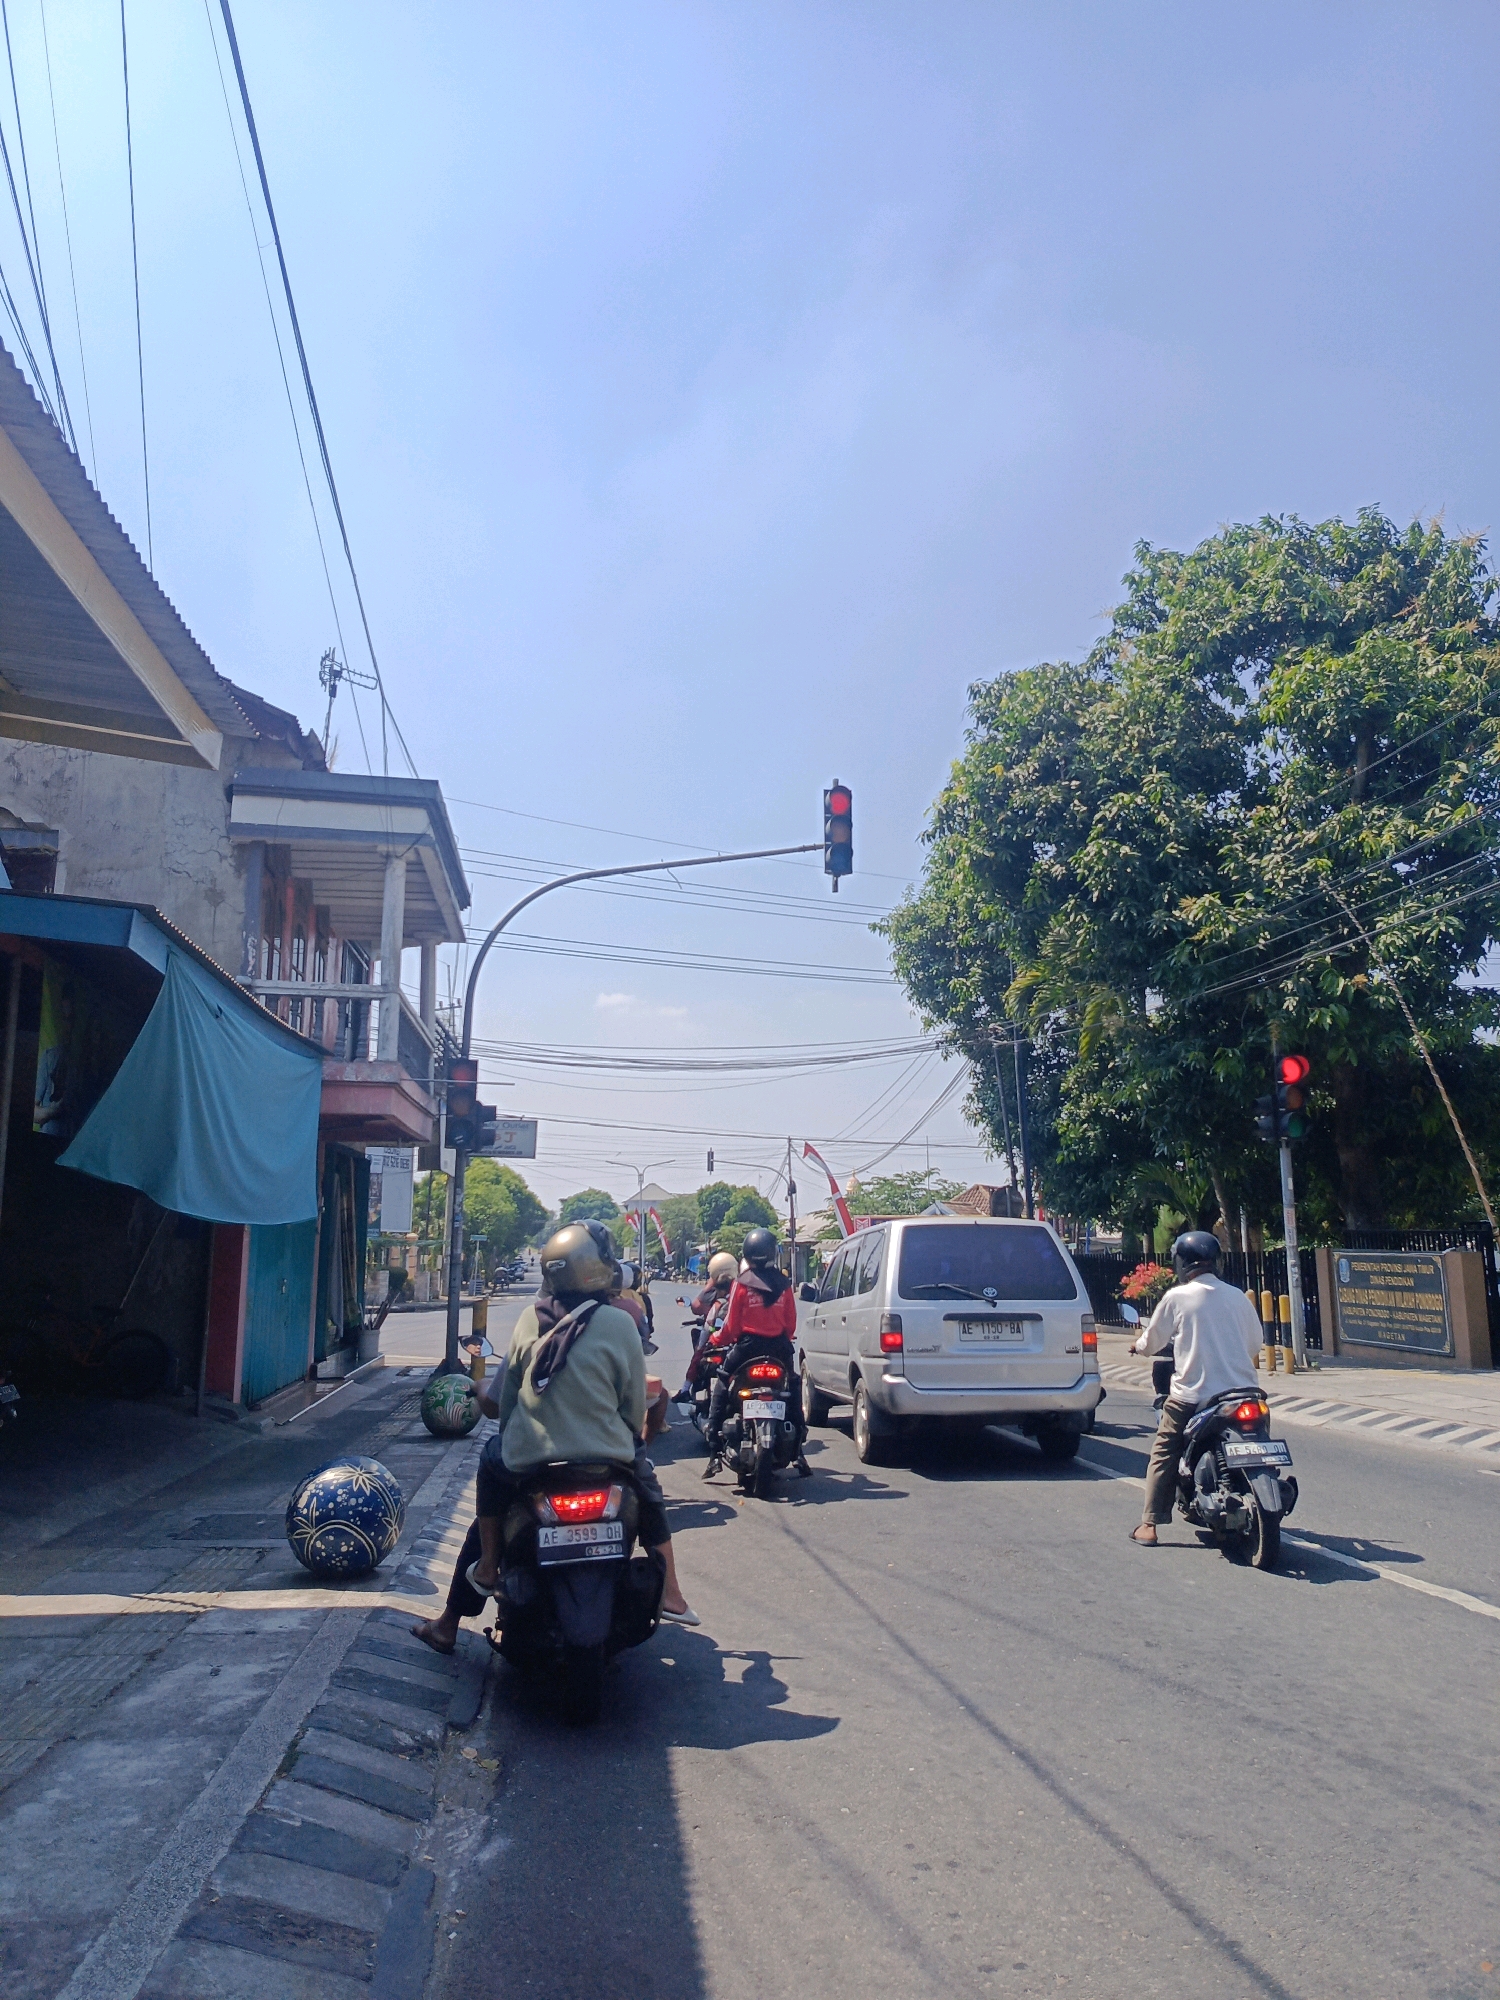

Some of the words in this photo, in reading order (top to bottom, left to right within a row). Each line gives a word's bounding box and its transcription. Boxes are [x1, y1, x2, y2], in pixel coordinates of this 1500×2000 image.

[961, 1322, 973, 1335] AE
[981, 1322, 1003, 1335] 1150
[1009, 1322, 1022, 1334] BA
[543, 1530, 558, 1545] AE
[567, 1527, 598, 1543] 3599
